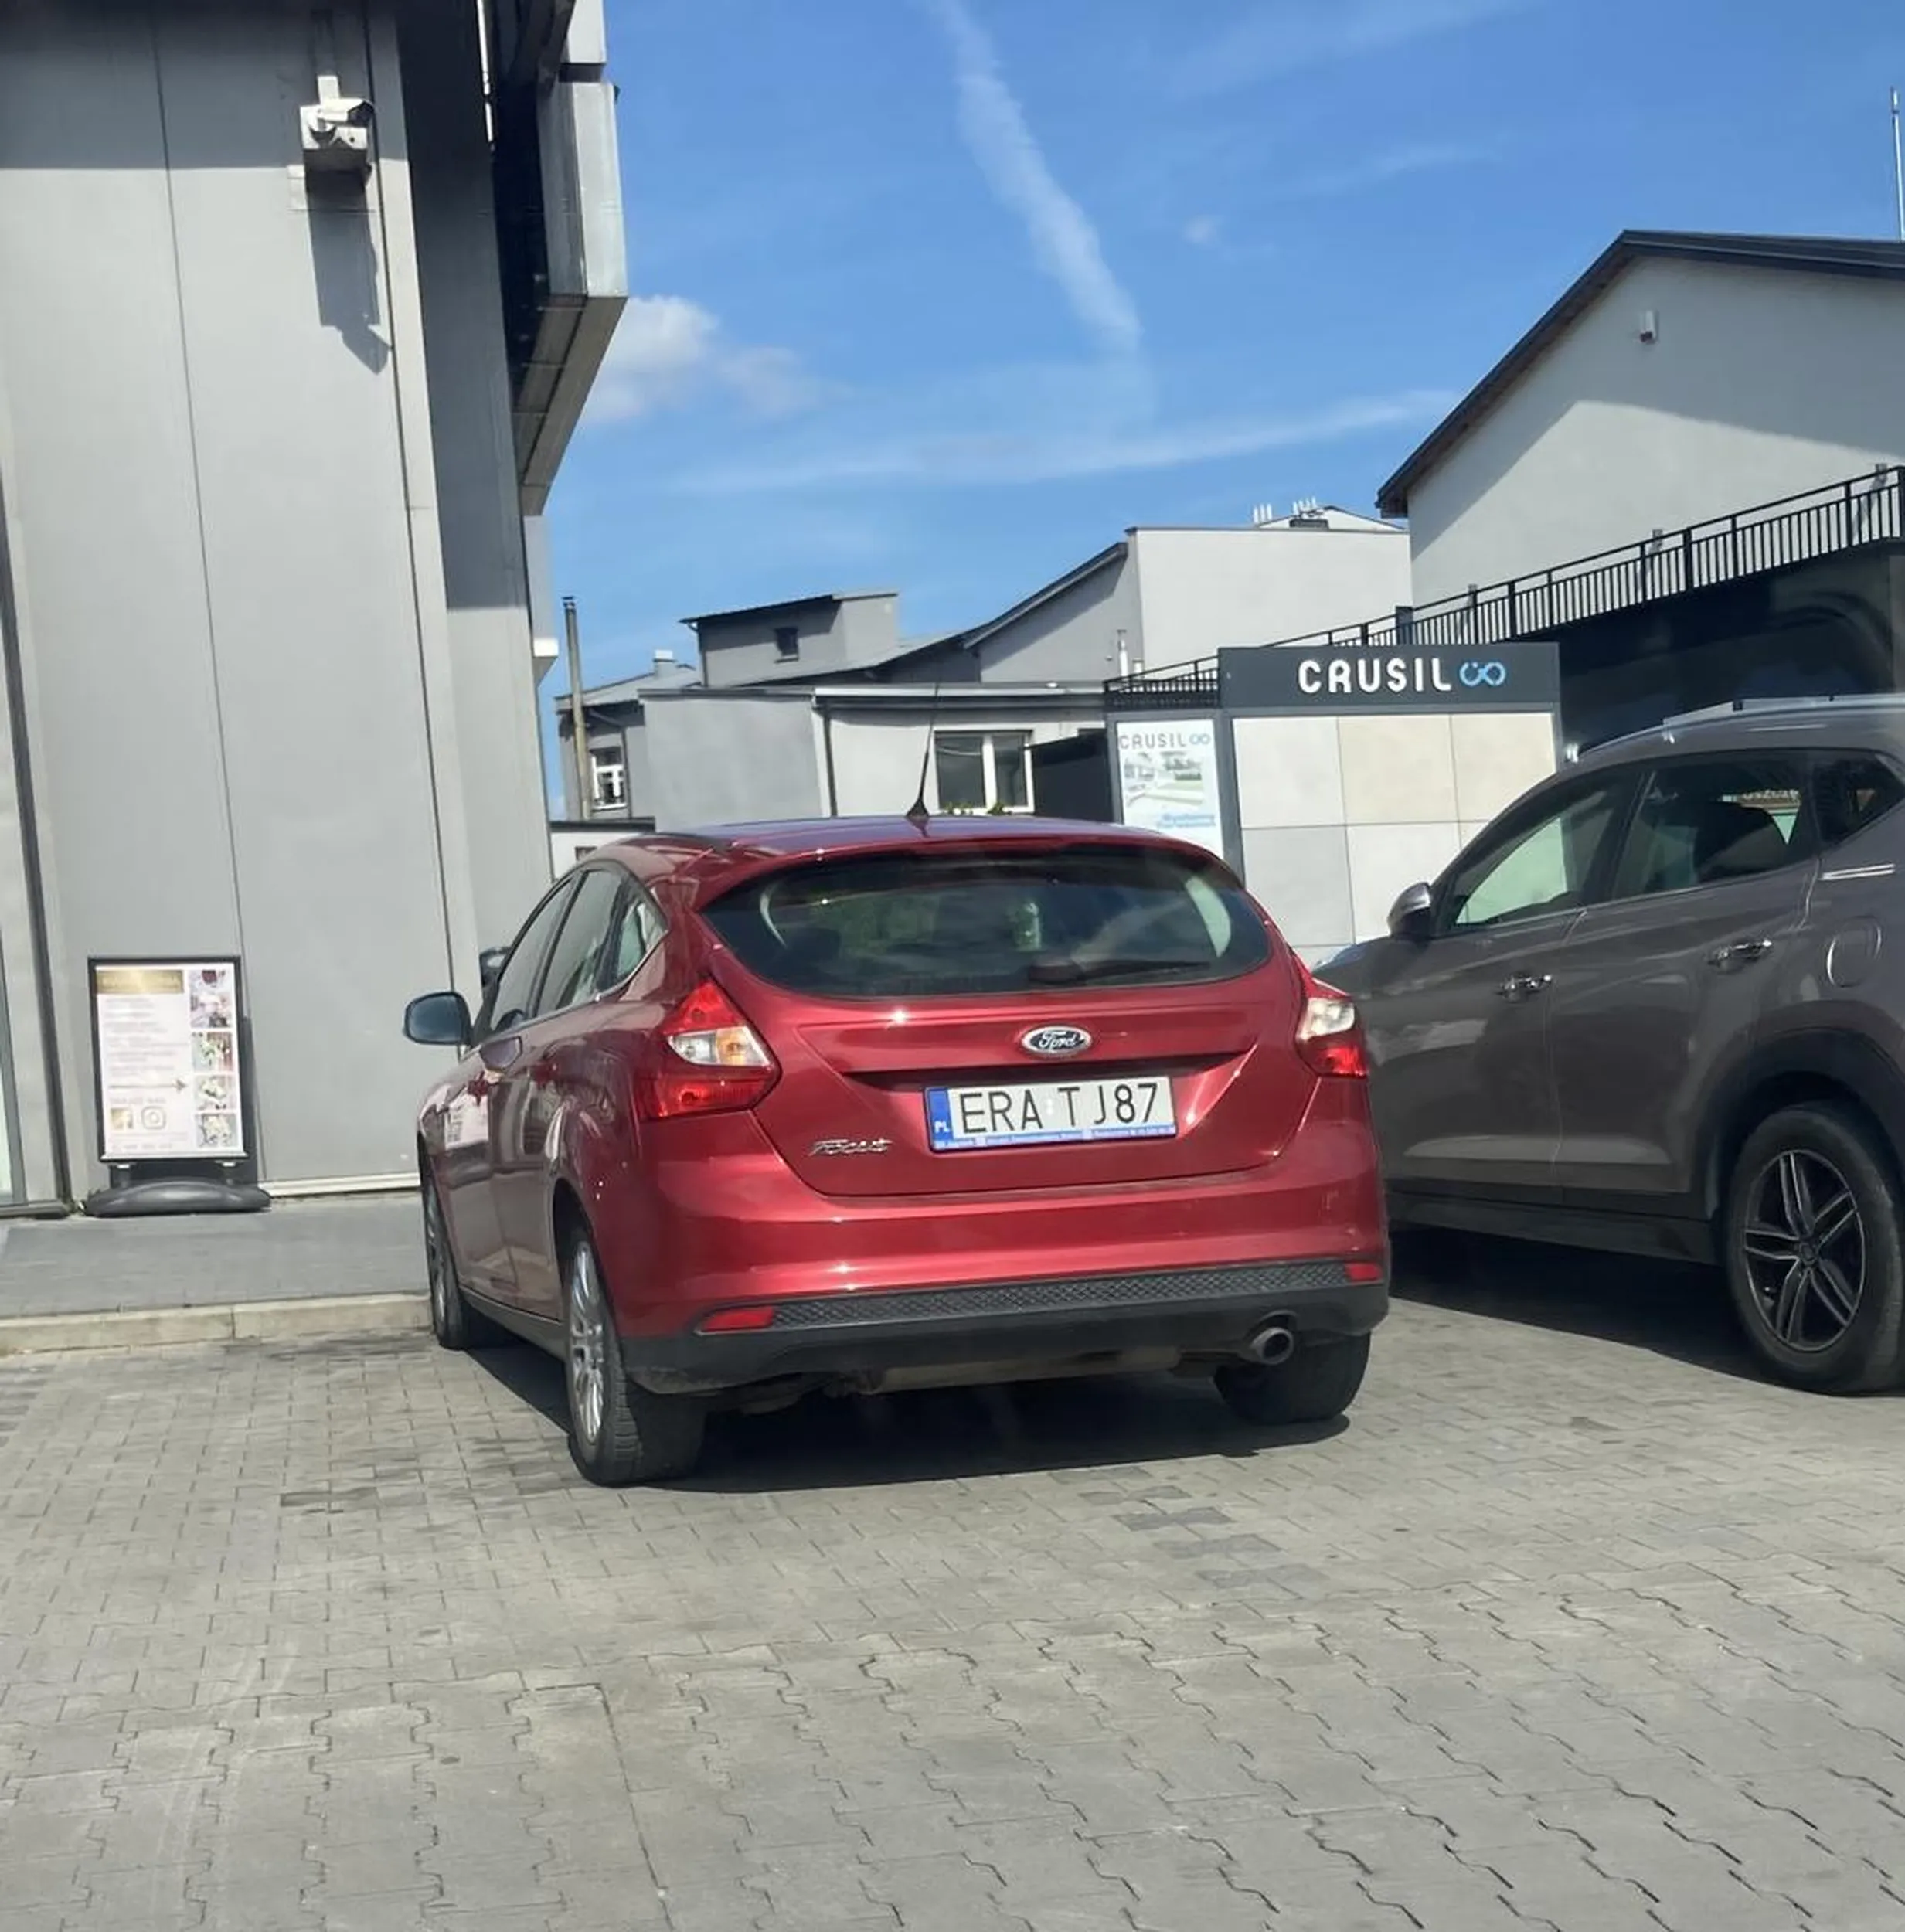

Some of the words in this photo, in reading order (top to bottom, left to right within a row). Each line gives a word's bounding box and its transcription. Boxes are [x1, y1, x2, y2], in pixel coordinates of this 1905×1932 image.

[1298, 657, 1452, 694] CRUSIL
[1039, 1031, 1077, 1053] Ford
[959, 1090, 1043, 1134] ERA
[934, 1121, 950, 1134] PL
